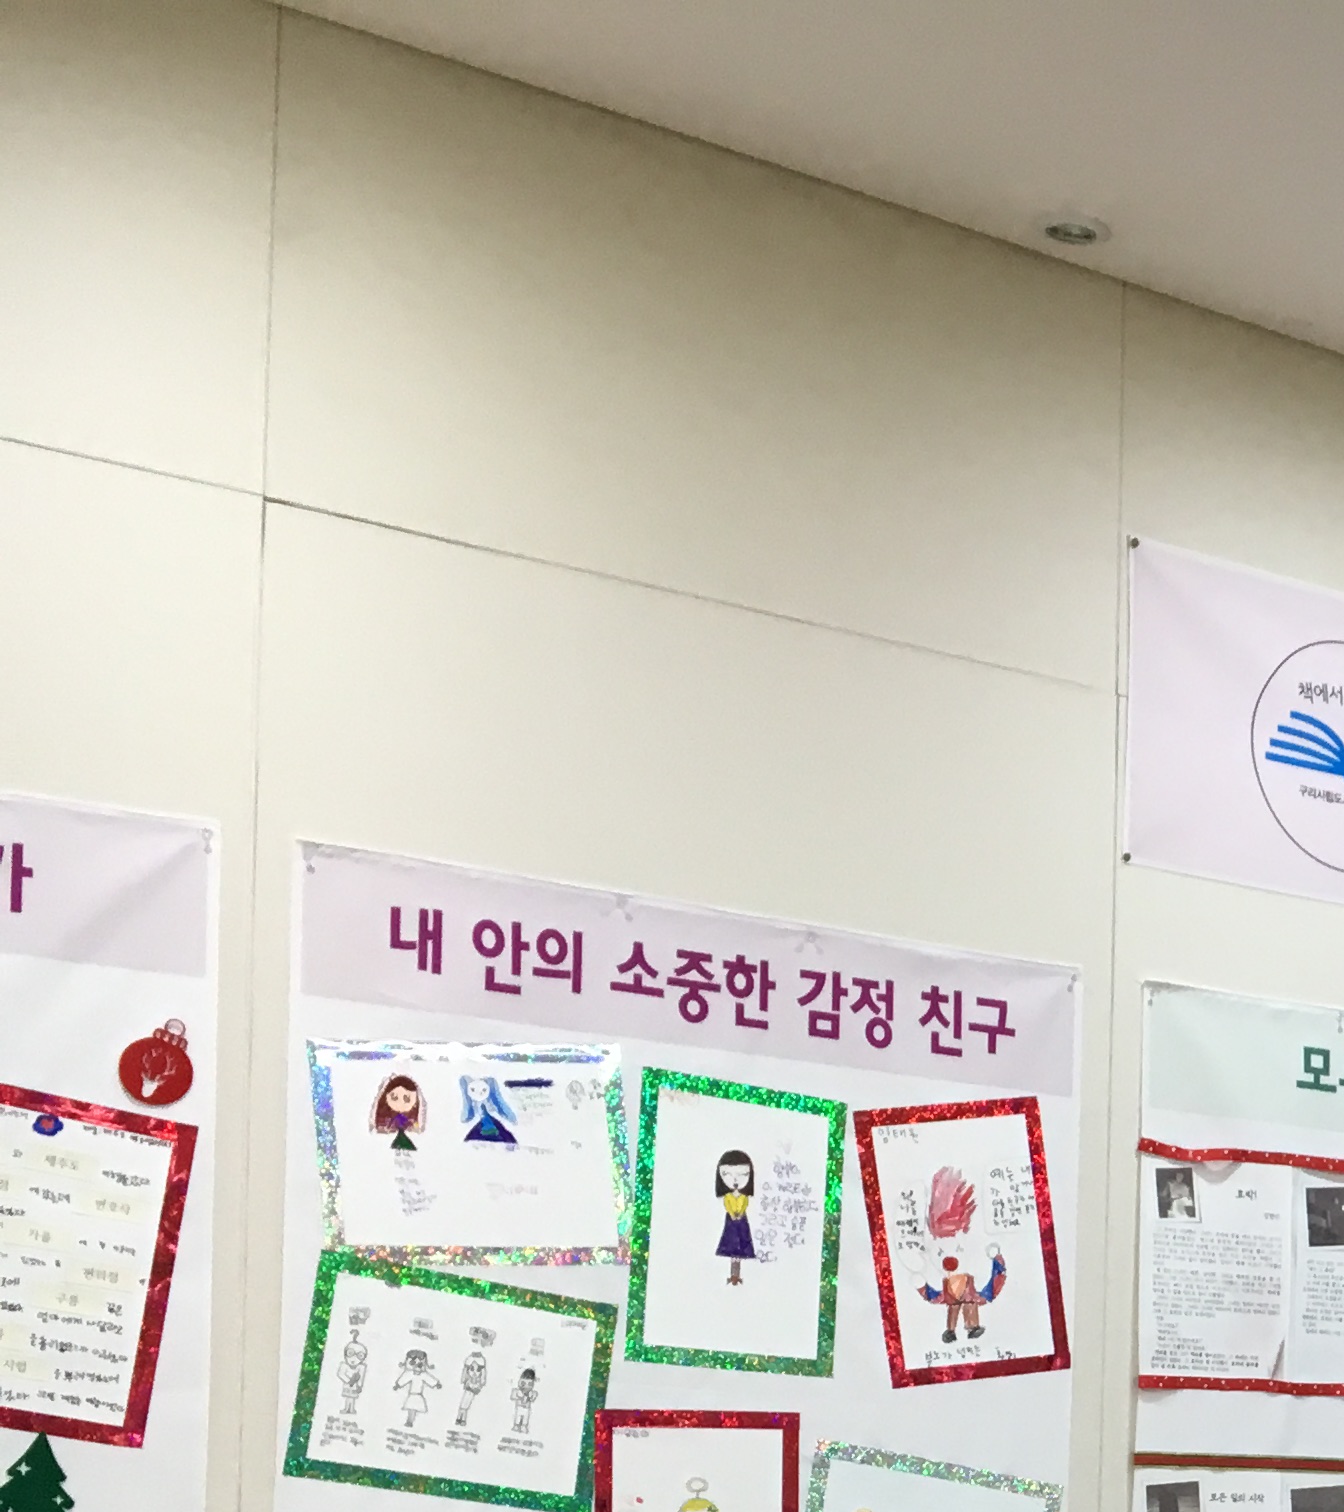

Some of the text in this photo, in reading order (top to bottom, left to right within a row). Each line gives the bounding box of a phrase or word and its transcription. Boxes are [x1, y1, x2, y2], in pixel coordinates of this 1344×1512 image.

[1297, 681, 1344, 706] 책에서
[388, 904, 1019, 1059] 내 안의 소중한 감정 친구
